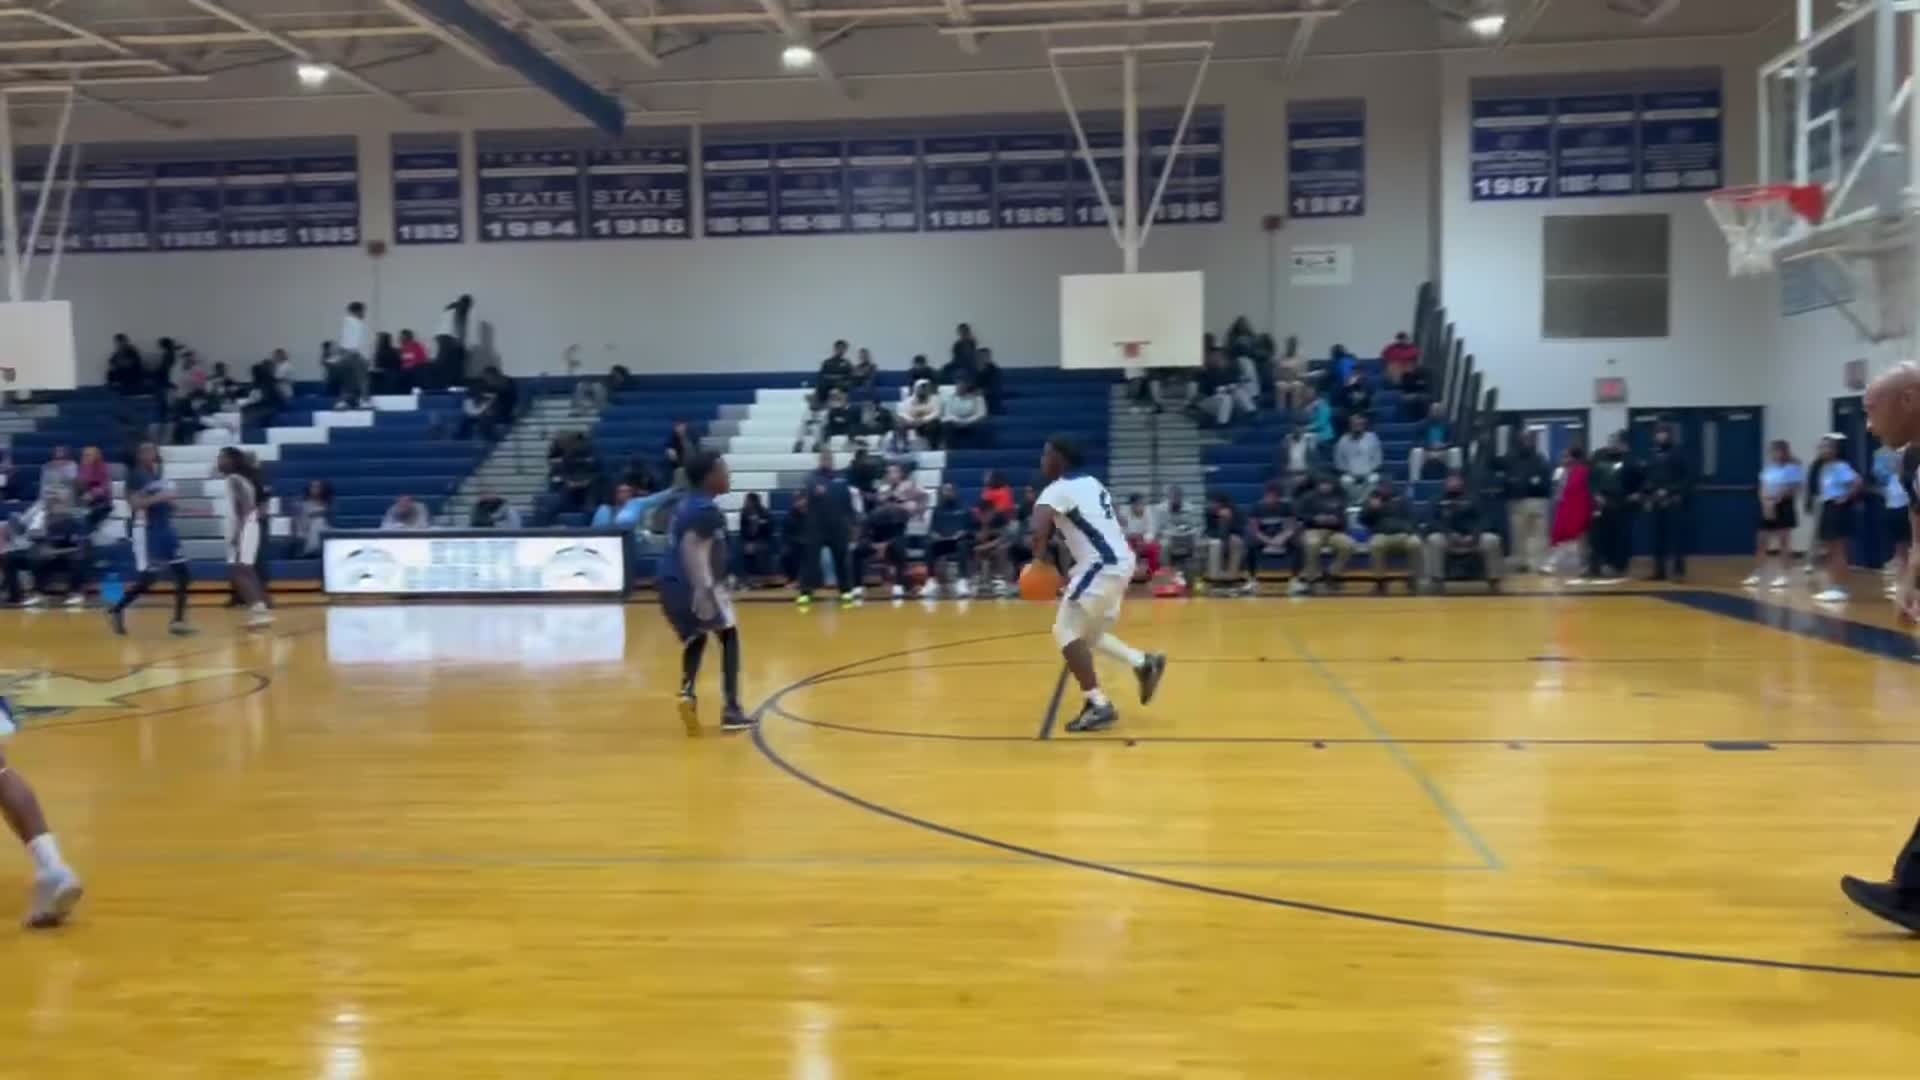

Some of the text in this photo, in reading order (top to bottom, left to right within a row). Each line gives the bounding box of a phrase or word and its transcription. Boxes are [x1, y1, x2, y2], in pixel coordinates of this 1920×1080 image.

[1475, 175, 1549, 195] 1987
[484, 190, 575, 206] STATE
[592, 188, 684, 203] STATE
[484, 220, 577, 238] 1984
[592, 217, 686, 235] 1986
